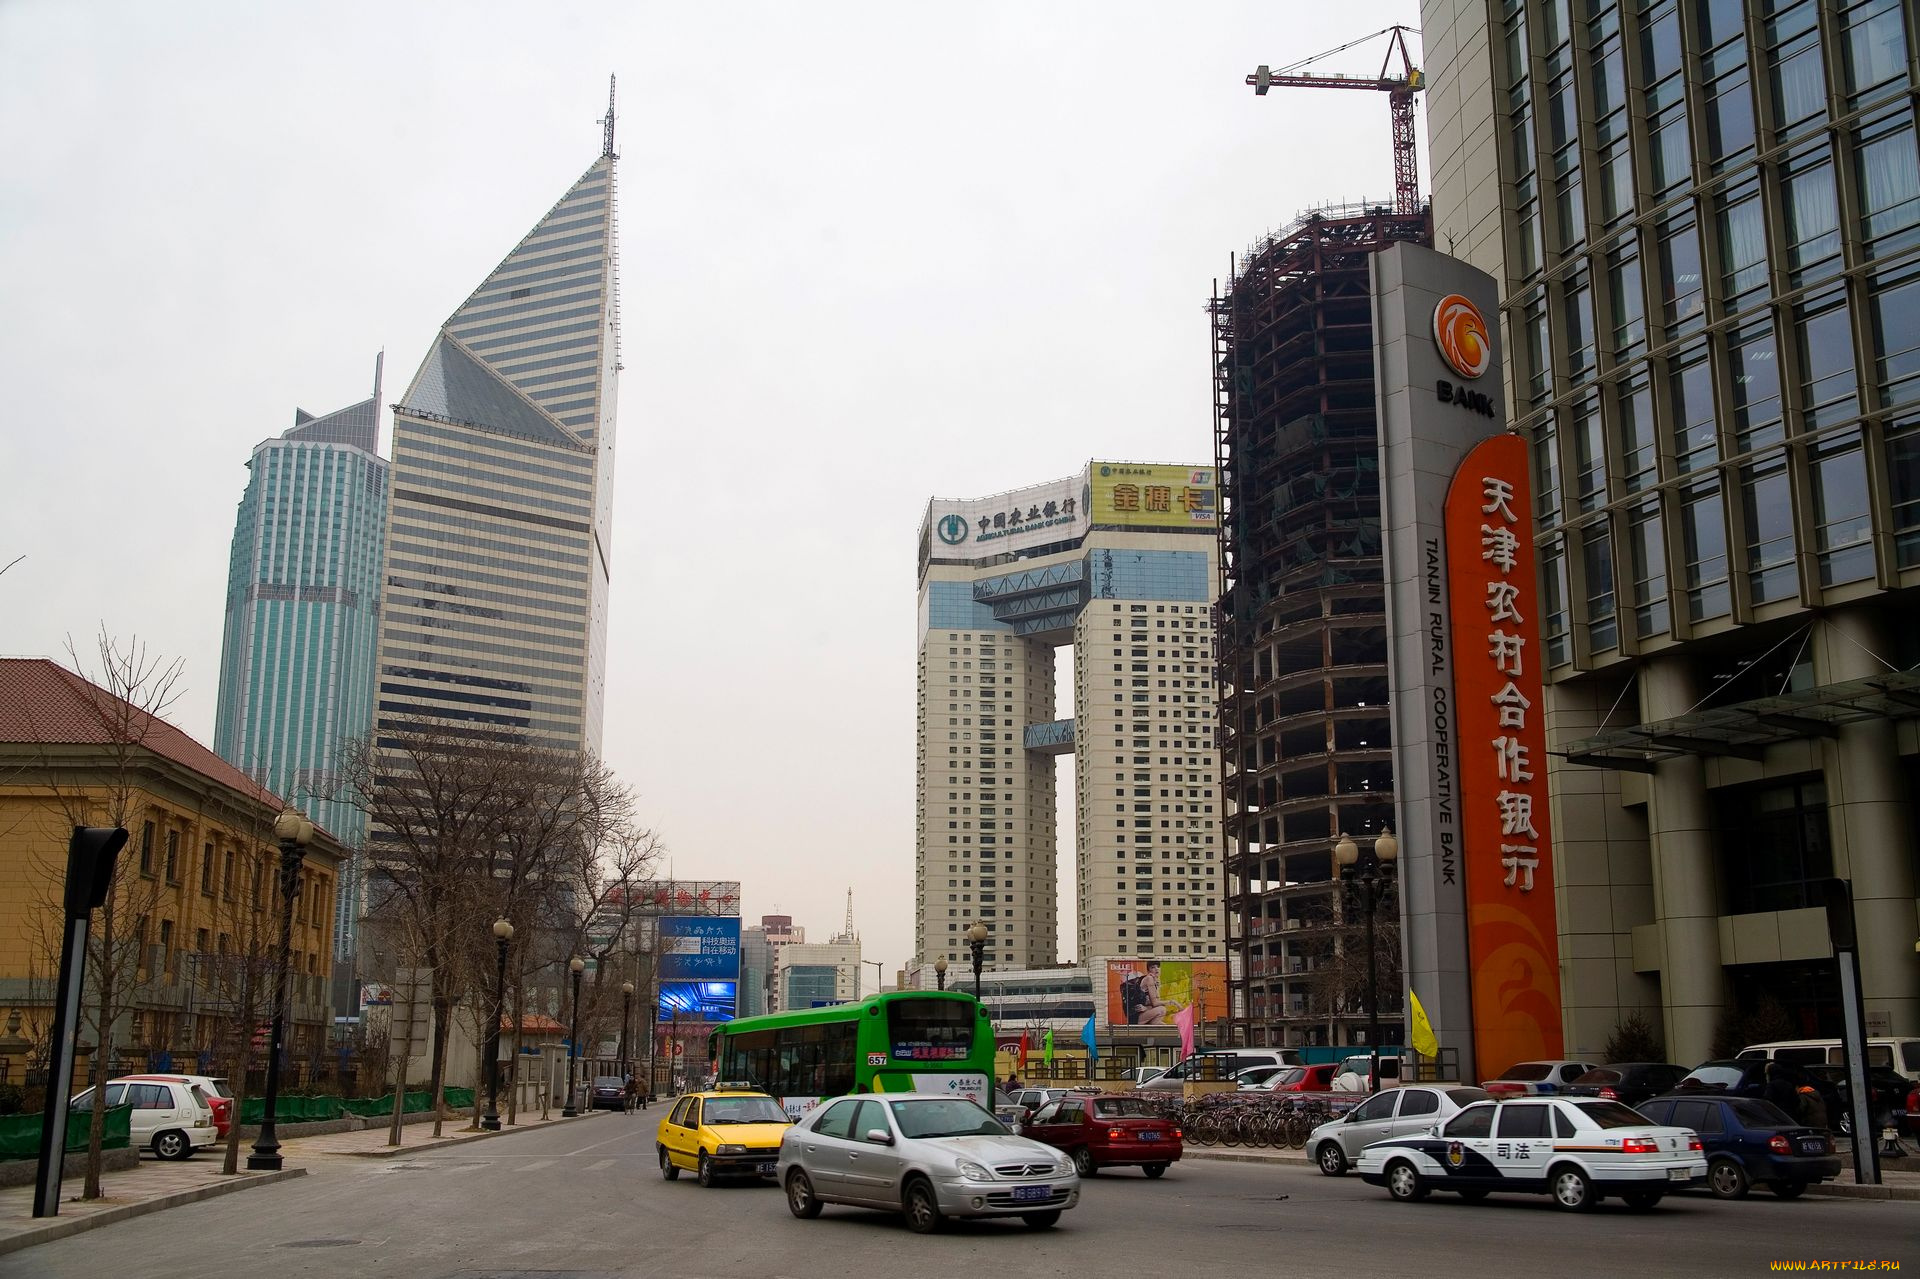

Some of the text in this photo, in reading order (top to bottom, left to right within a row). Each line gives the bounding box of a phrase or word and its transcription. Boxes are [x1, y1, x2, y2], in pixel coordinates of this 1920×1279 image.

[1437, 380, 1495, 419] BANK
[1113, 483, 1203, 512] 金穗卡
[976, 515, 1076, 542] AGRICULTURAL BANK OF CHINA
[978, 498, 1076, 534] 中国农业银行
[1481, 477, 1539, 892] 天津农村合作银行
[1426, 537, 1455, 886] TIANJIN RURAL COOPERATIVE BANK
[702, 946, 736, 955] 自在移动
[868, 1056, 887, 1065] 657
[1497, 1143, 1530, 1160] 司法
